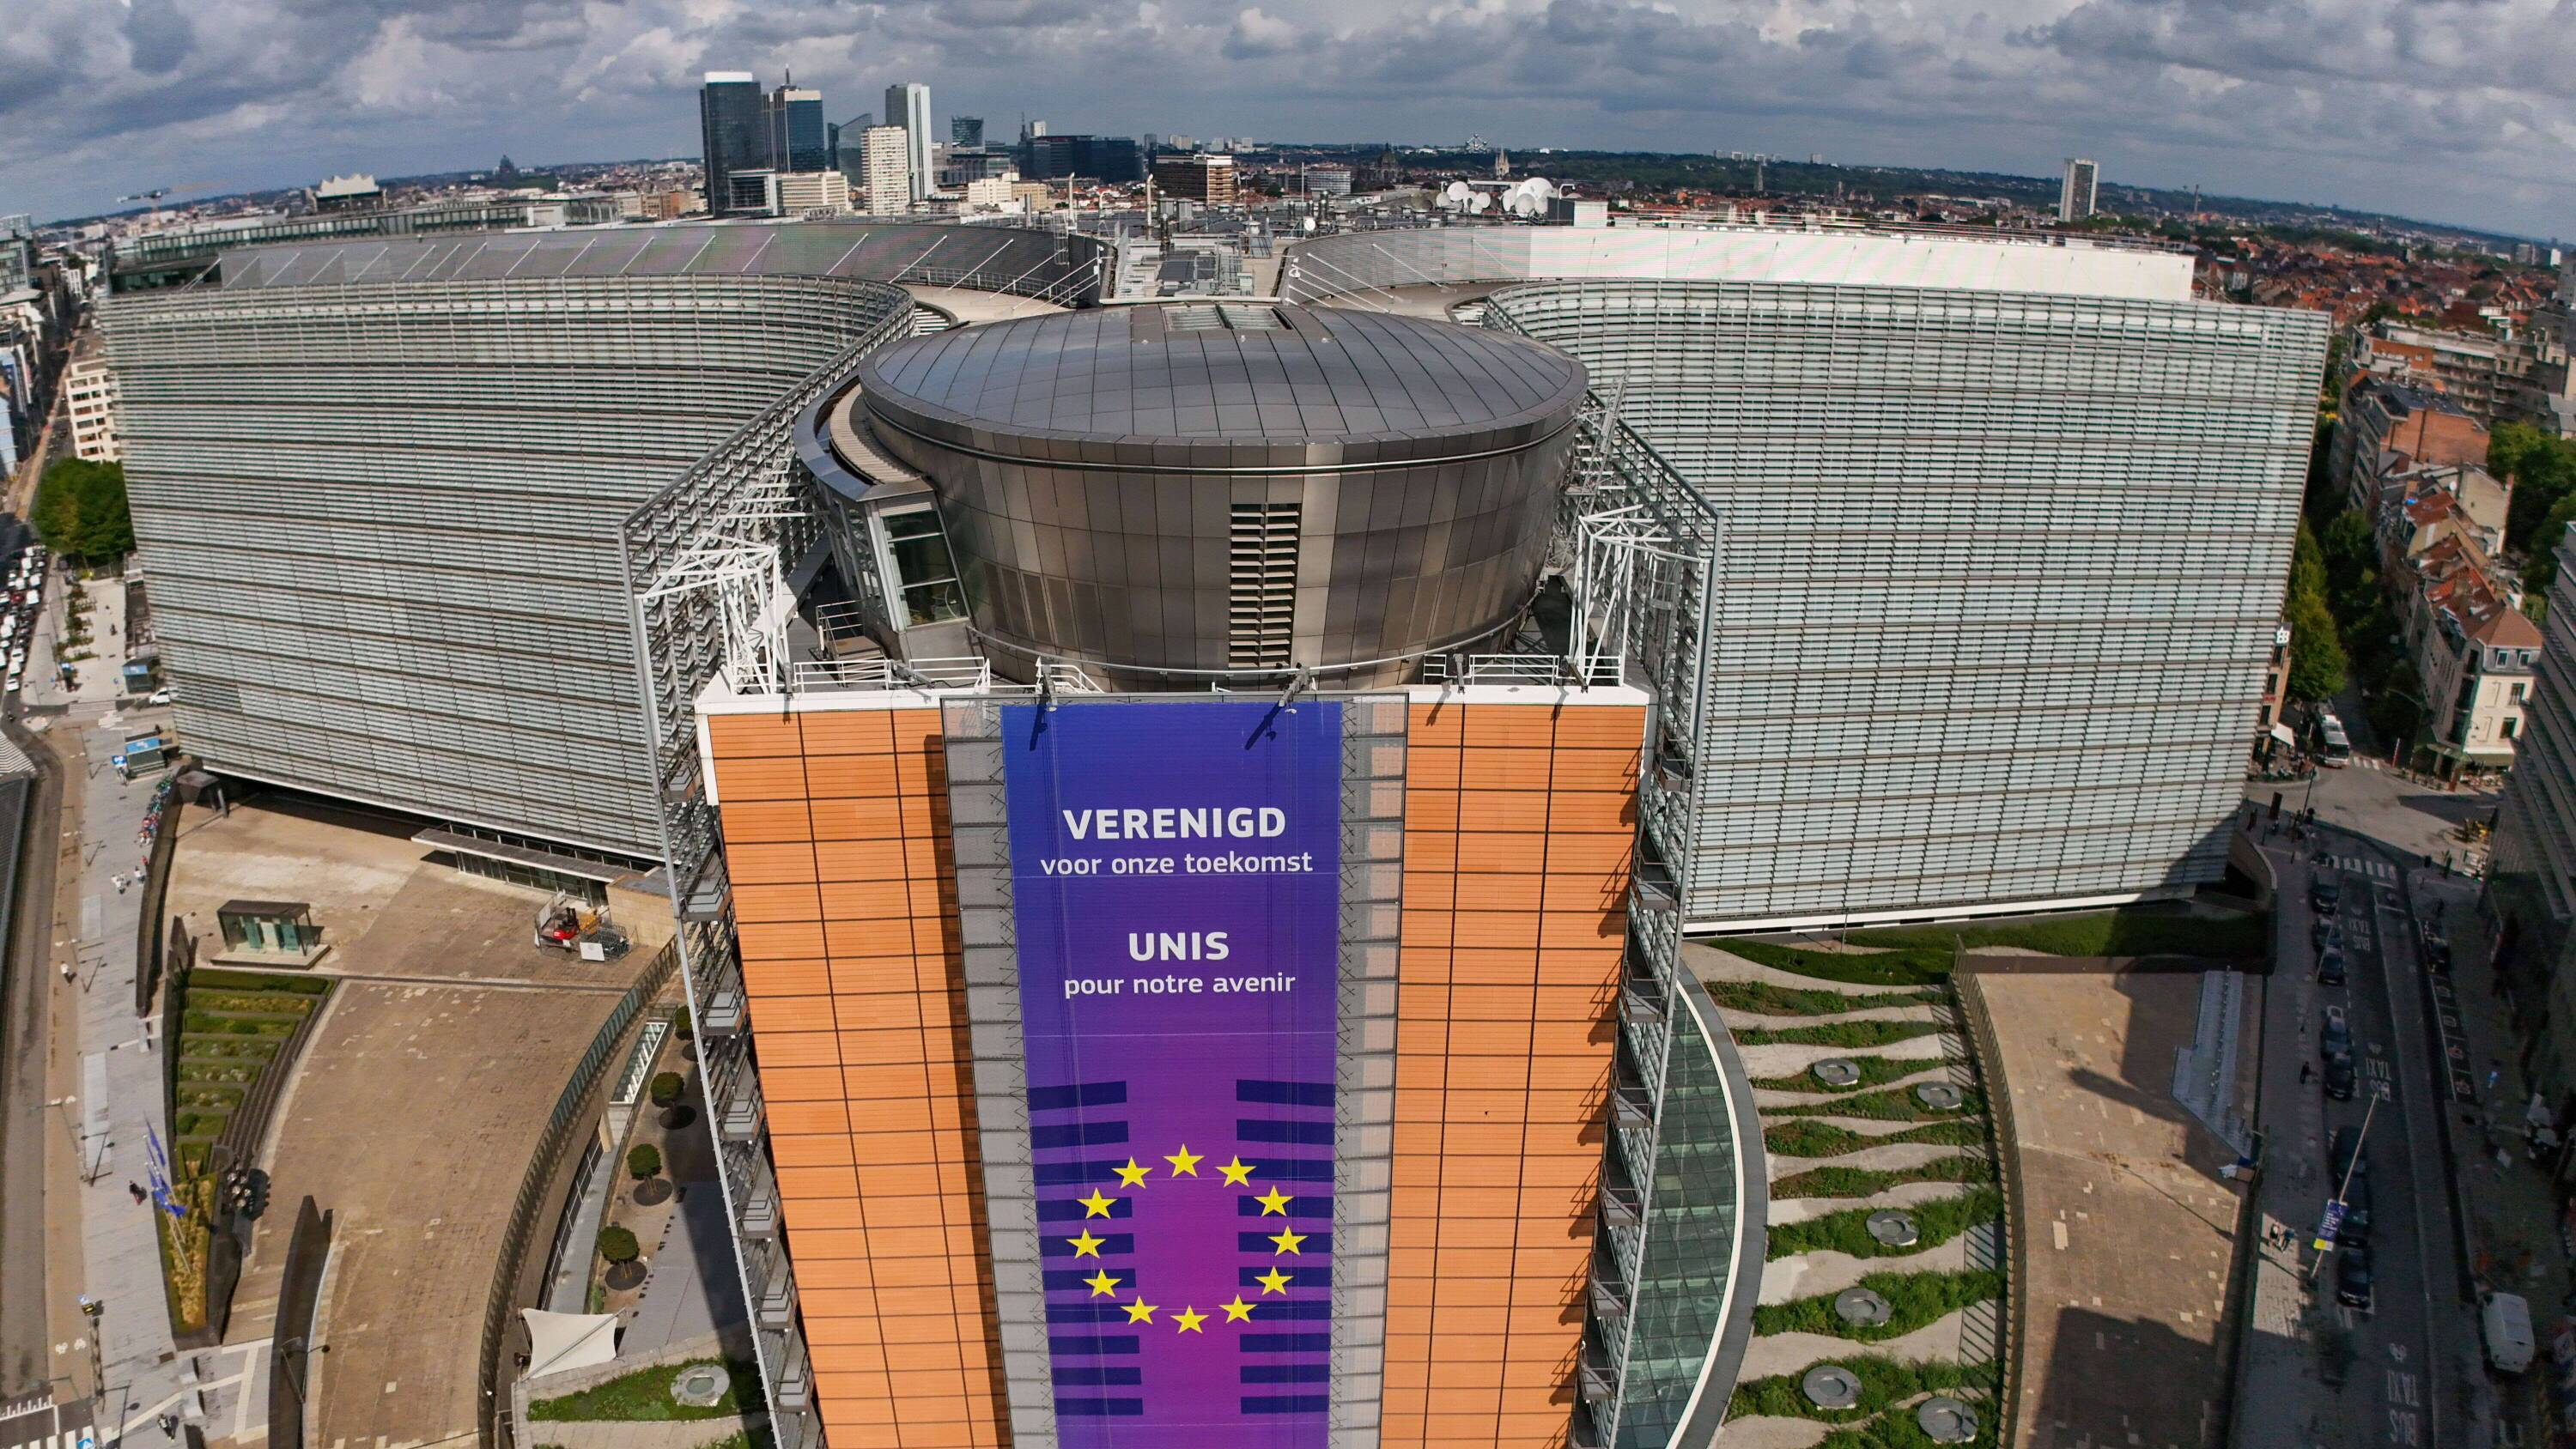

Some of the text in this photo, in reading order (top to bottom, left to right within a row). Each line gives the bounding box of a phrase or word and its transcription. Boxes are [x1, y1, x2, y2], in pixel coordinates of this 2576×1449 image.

[1062, 807, 1286, 840] VERENIGD
[1040, 850, 1314, 876] voor onze toekomst
[1128, 931, 1230, 961] UNIS
[1064, 972, 1296, 999] pour notre avenir
[2366, 1058, 2391, 1080] TAXI
[2387, 1370, 2420, 1407] TAXI
[2390, 1409, 2417, 1446] BUS
